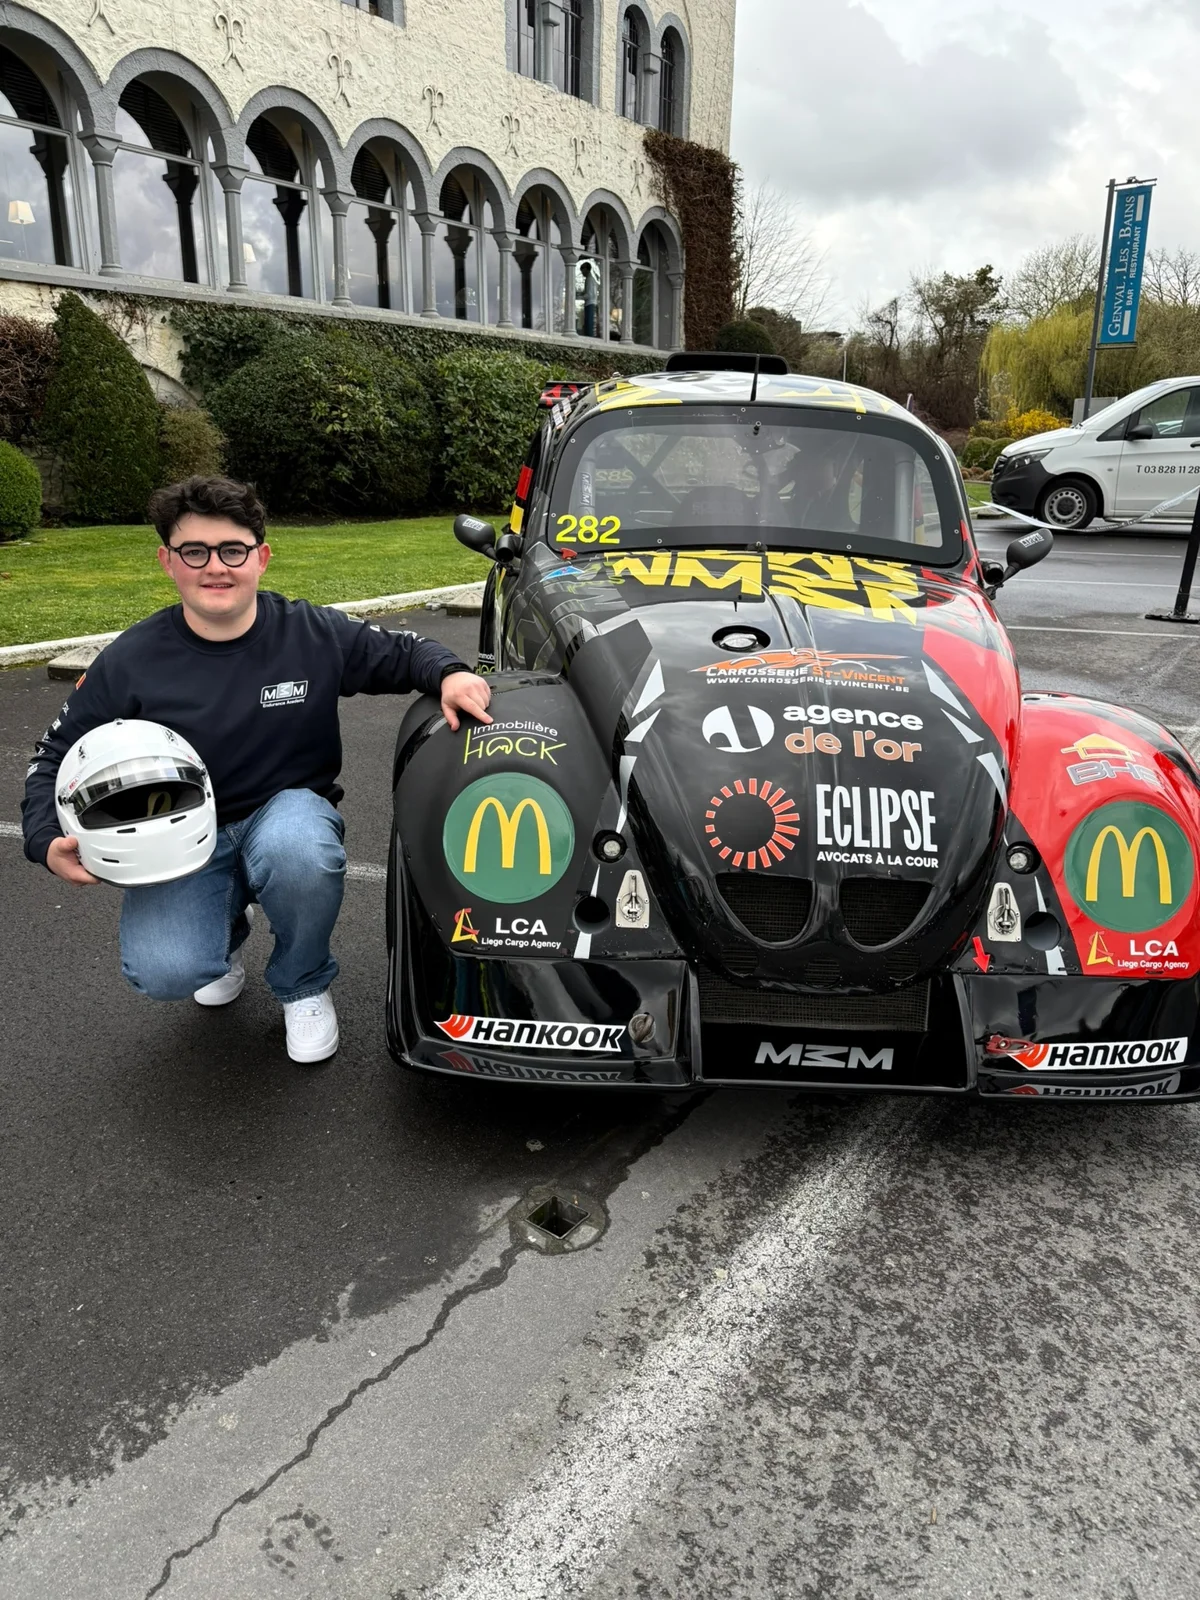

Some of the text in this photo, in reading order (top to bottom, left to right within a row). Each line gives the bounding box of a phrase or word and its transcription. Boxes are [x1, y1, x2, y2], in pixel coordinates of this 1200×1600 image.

[1108, 195, 1136, 336] GENVAL LES BAINS
[1126, 226, 1142, 306] BAR RESTAURANT
[1136, 464, 1200, 474] T 03 828 11 28
[556, 514, 621, 545] 282
[783, 704, 924, 731] agence
[473, 720, 558, 737] Immobilière
[784, 726, 922, 763] de l'or
[815, 783, 939, 853] ECLIPSE
[816, 850, 939, 869] AVOCATS À LA COUR
[495, 917, 548, 935] LCA
[481, 938, 561, 949] Liege Cargo Agency
[1129, 939, 1179, 956] LCA
[1117, 960, 1189, 970] Liege Cargo Agency
